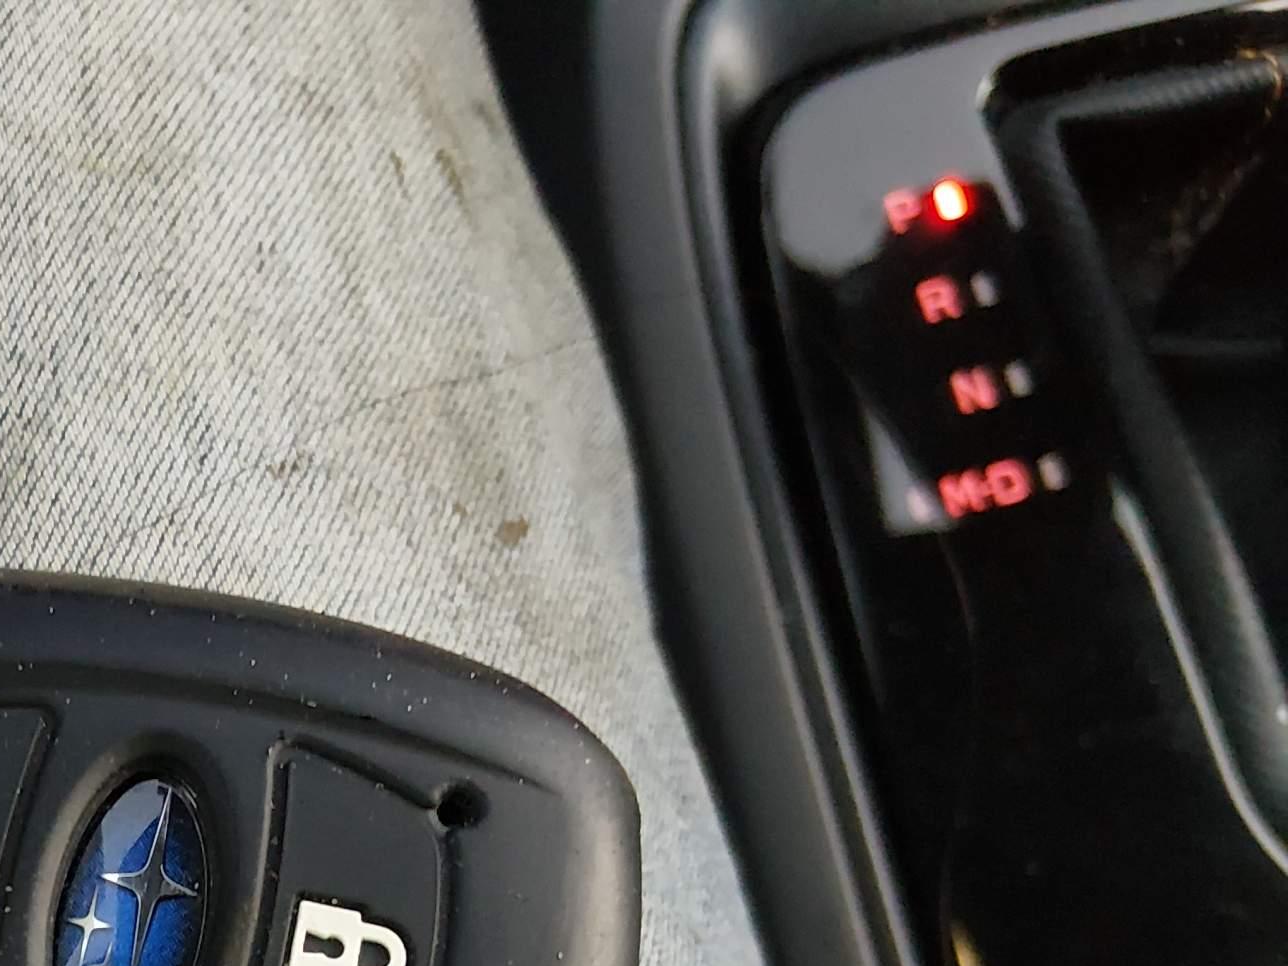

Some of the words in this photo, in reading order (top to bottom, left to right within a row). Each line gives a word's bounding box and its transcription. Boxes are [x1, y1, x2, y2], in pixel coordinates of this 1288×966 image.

[883, 188, 922, 235] P
[915, 274, 964, 324] R
[949, 365, 1000, 415] N
